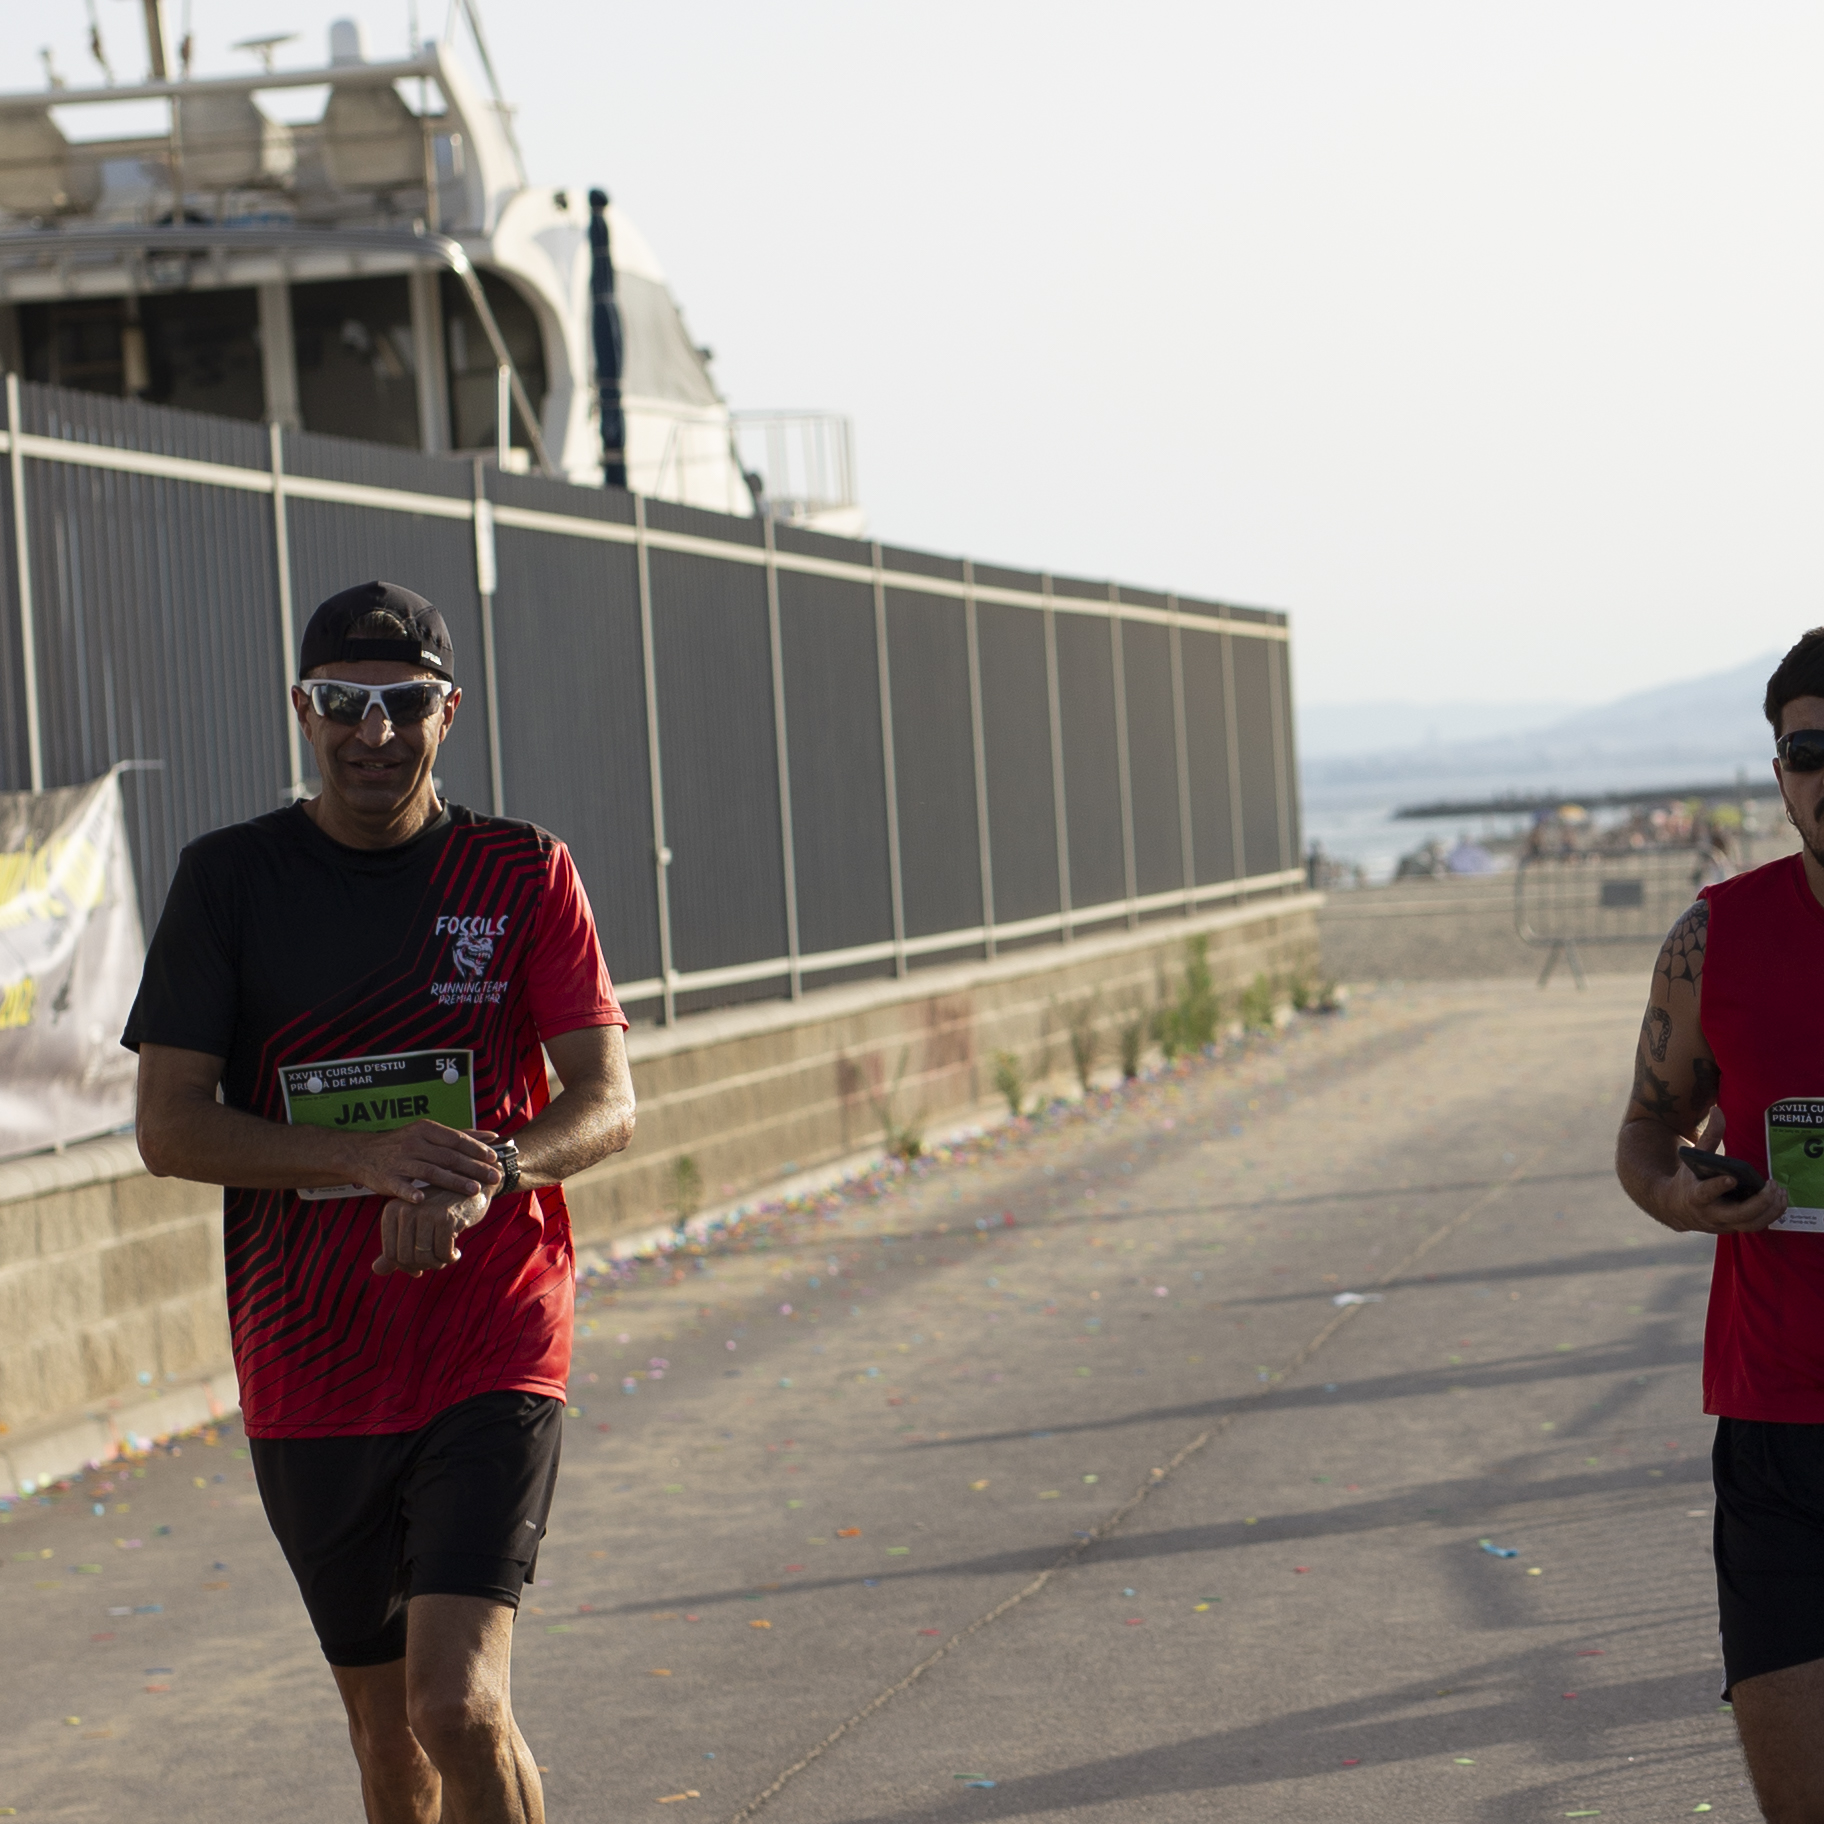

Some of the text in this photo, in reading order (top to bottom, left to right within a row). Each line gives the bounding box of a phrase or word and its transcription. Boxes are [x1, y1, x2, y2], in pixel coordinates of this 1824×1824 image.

[435, 914, 509, 936] FOSSILS
[430, 980, 509, 996] RUNNING TEAM
[288, 1058, 457, 1082] XXVIII CURSA D'ESTIU 5K
[290, 1075, 373, 1092] PRÀ DE MAR
[334, 1094, 430, 1126] JAVIER
[1772, 1104, 1808, 1113] XXVIII
[1772, 1113, 1813, 1124] PREMIÀ
